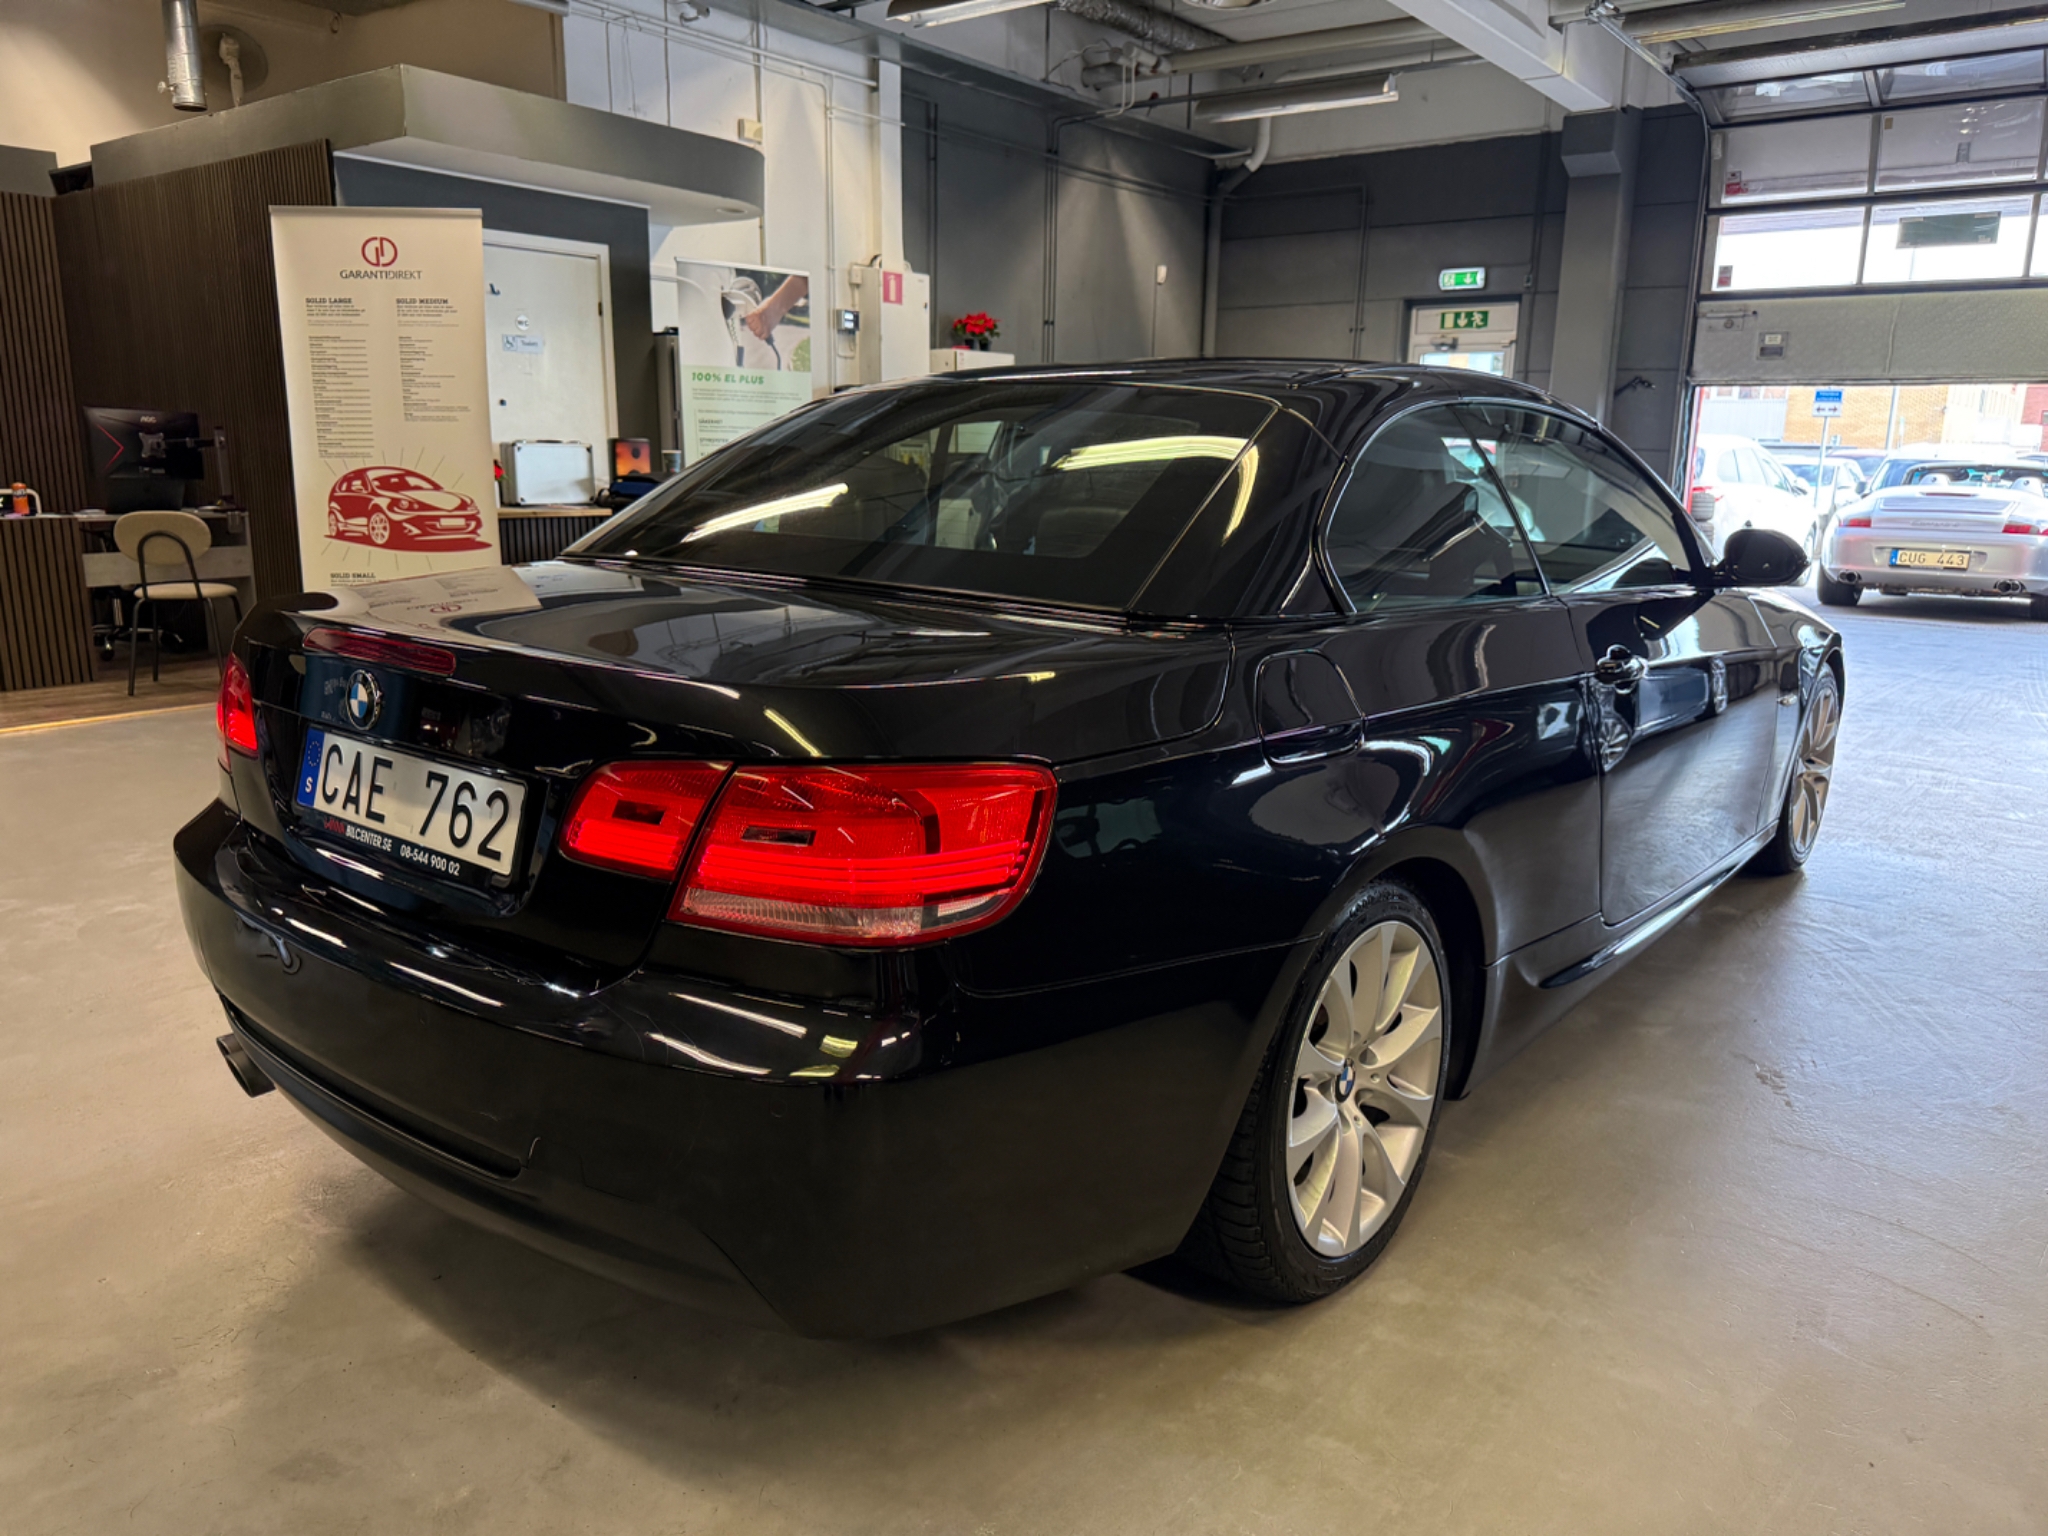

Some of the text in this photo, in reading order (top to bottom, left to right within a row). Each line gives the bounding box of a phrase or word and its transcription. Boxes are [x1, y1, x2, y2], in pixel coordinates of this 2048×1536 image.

[339, 269, 422, 280] GARANTIDIREKT
[418, 297, 448, 305] MEDIUM
[691, 371, 765, 385] 100% EL PLUS
[1898, 551, 1966, 566] CUG 443
[304, 776, 314, 794] S
[321, 743, 510, 862] CAE 762
[399, 844, 429, 867] 08-544
[430, 854, 447, 872] 900
[448, 861, 460, 876] 02
